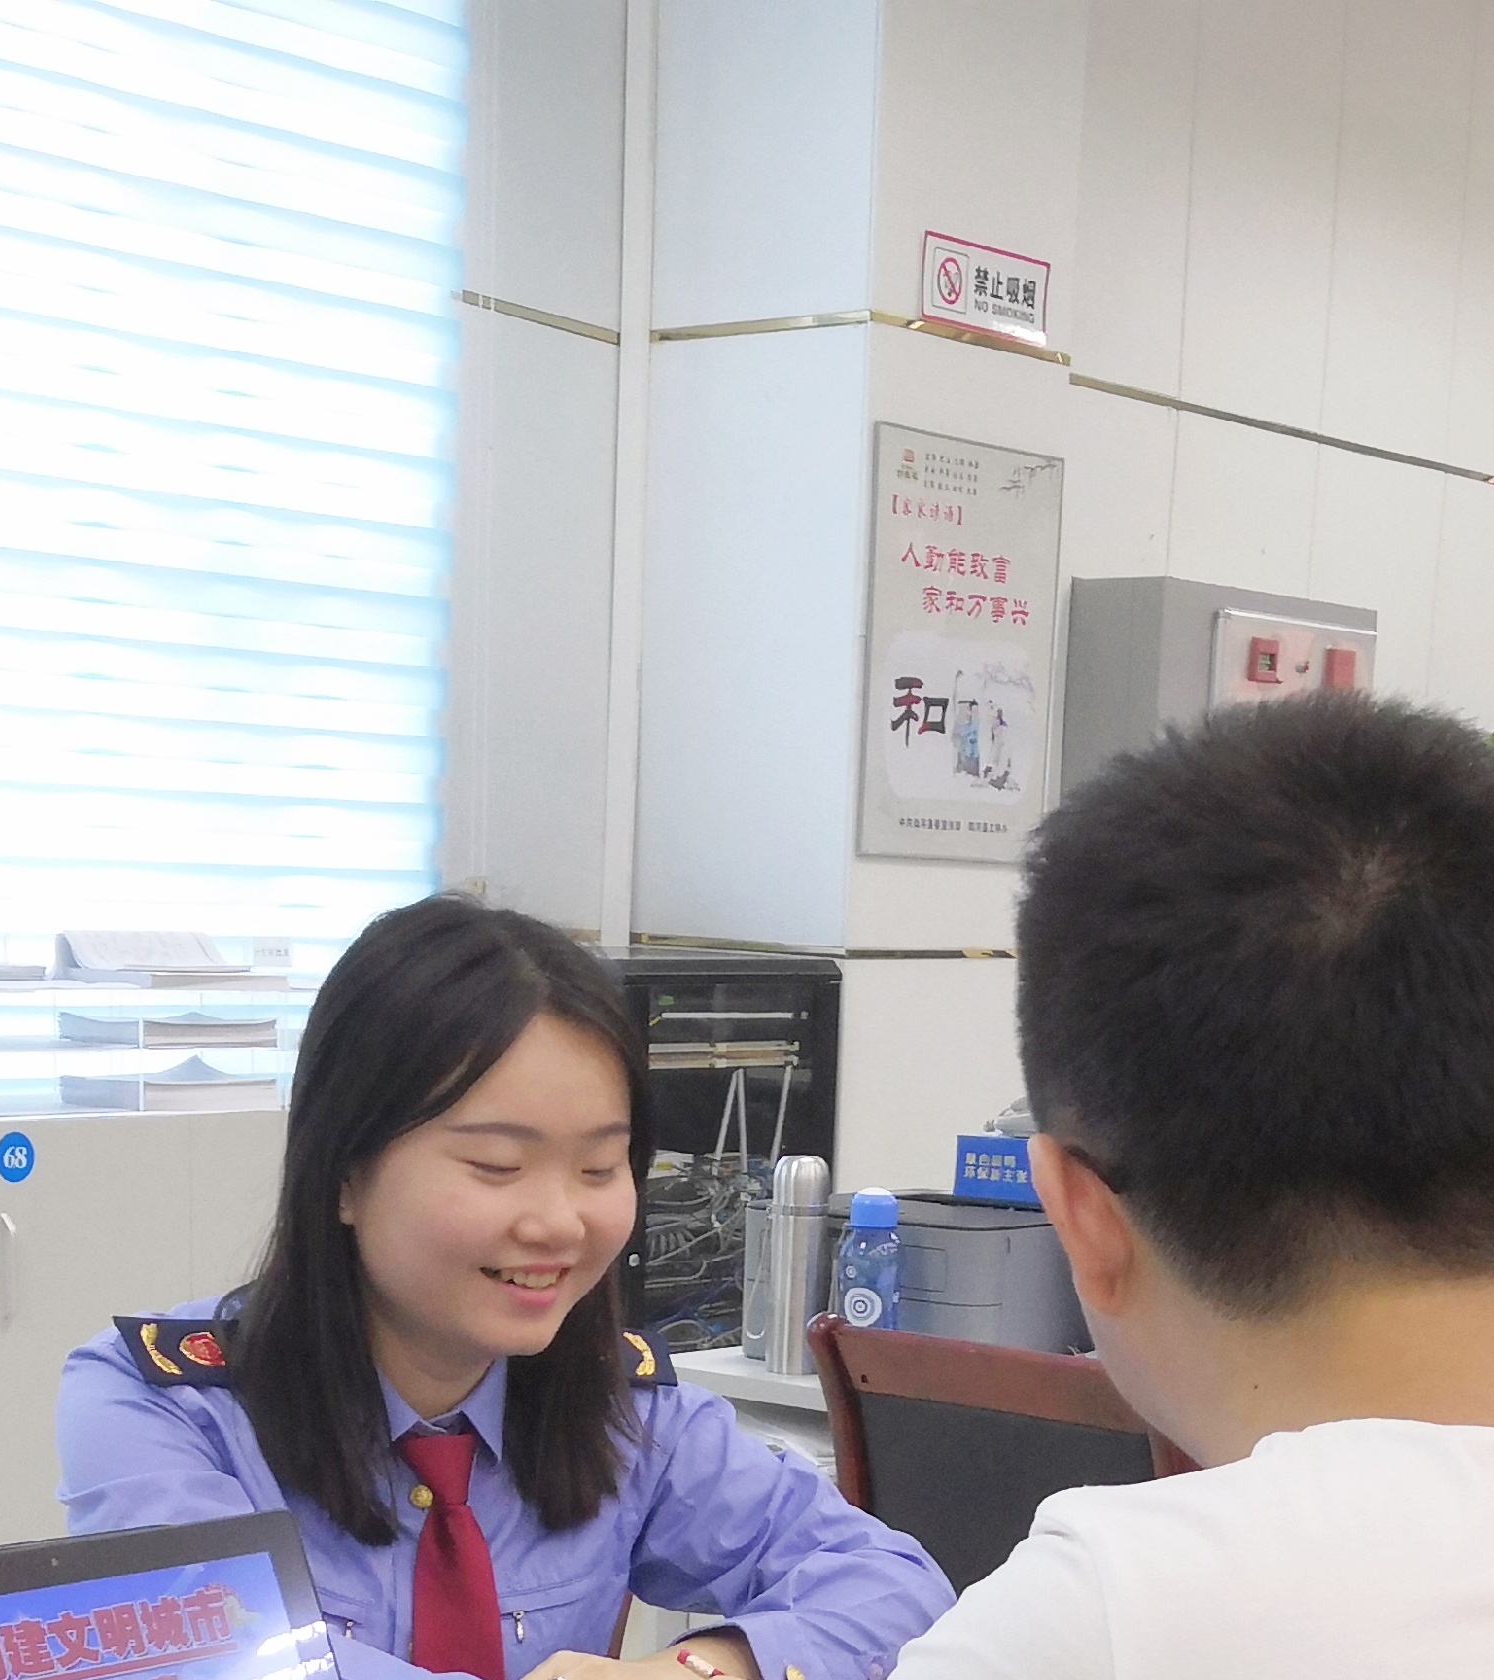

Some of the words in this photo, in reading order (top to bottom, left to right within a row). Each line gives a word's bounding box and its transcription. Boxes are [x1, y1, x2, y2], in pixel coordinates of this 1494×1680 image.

[974, 265, 1036, 309] 禁止吸烟
[974, 299, 989, 313] NO
[991, 302, 1035, 324] SMOKING
[901, 542, 1011, 584] 人勤能致富
[922, 586, 1029, 626] 家和万事兴
[890, 676, 950, 747] 和
[3, 1146, 27, 1169] 68
